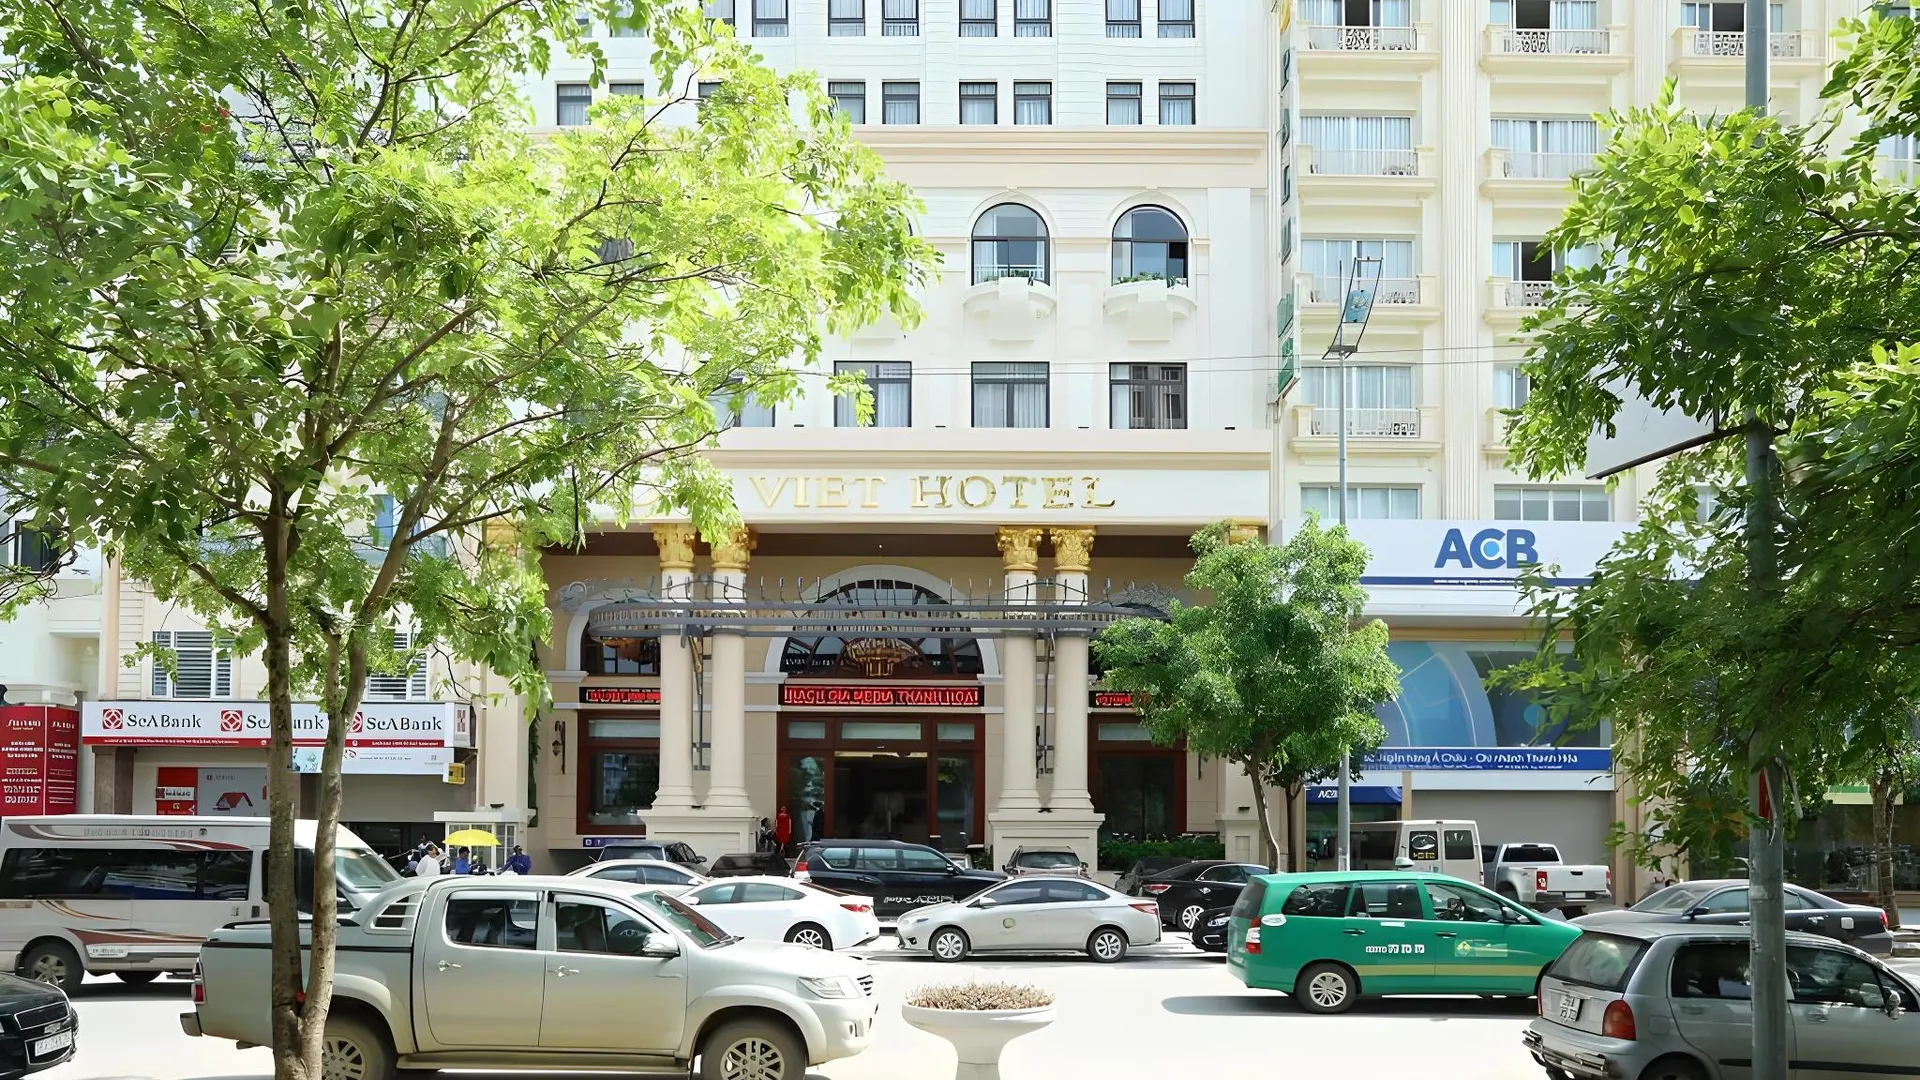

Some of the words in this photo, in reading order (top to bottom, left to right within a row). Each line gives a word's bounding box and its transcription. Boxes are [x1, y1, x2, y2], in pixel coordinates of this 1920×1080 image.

[749, 477, 886, 509] VIET
[909, 475, 1116, 509] HOTEL
[1434, 528, 1539, 570] ACB
[127, 714, 201, 728] SeABank
[246, 714, 324, 730] Seank
[366, 715, 442, 731] SeABank
